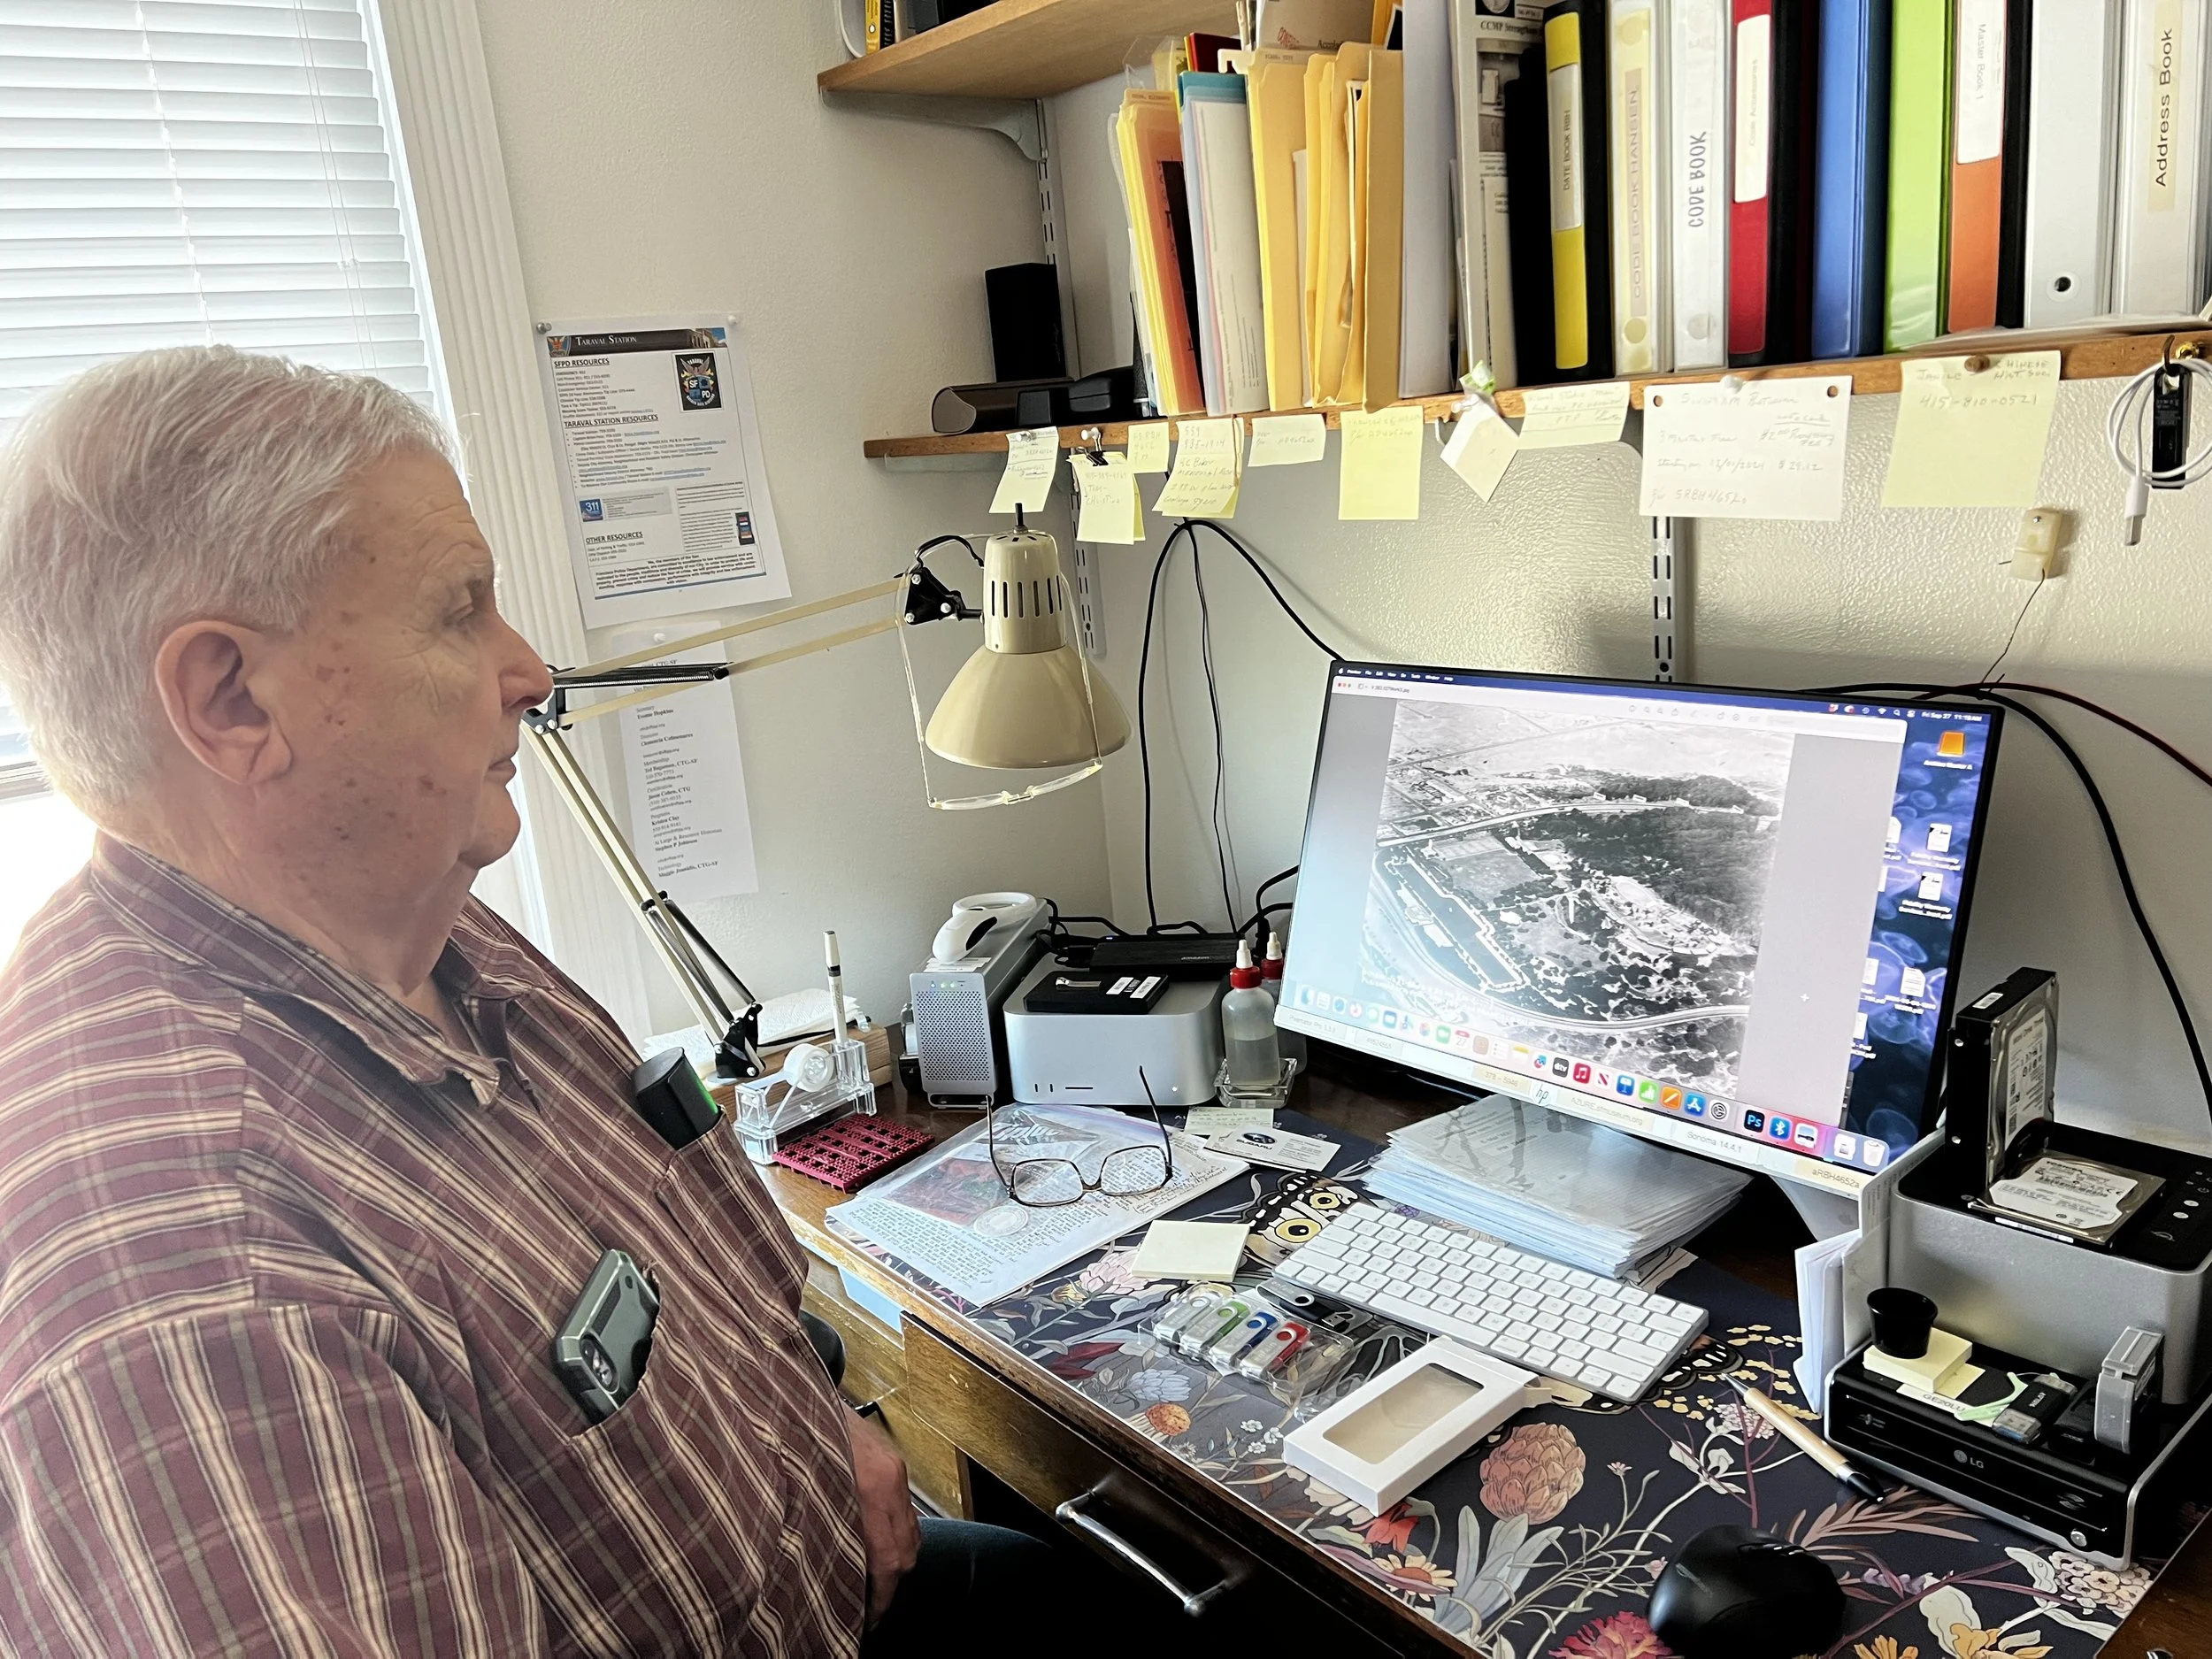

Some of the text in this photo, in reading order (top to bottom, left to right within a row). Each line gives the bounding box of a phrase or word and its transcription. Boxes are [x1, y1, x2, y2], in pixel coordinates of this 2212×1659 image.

[1978, 23, 1986, 59] Master
[1976, 64, 1985, 91] Book
[2155, 27, 2173, 187] Address Book
[1688, 131, 1707, 228] CODE BOOK
[1629, 89, 1642, 297] CODE BOOK HANSEN
[565, 419, 593, 427] TARAVAL
[586, 502, 599, 512] 311
[607, 532, 643, 541] RESOURCES
[1536, 1084, 1548, 1104] hp
[1747, 1115, 1762, 1128] Ps
[1236, 1139, 1272, 1150] SUBARU
[1687, 1131, 1742, 1153] Sonoma 14.4.1
[1922, 1394, 1966, 1413] GE20LU
[1970, 1456, 1984, 1469] LG
